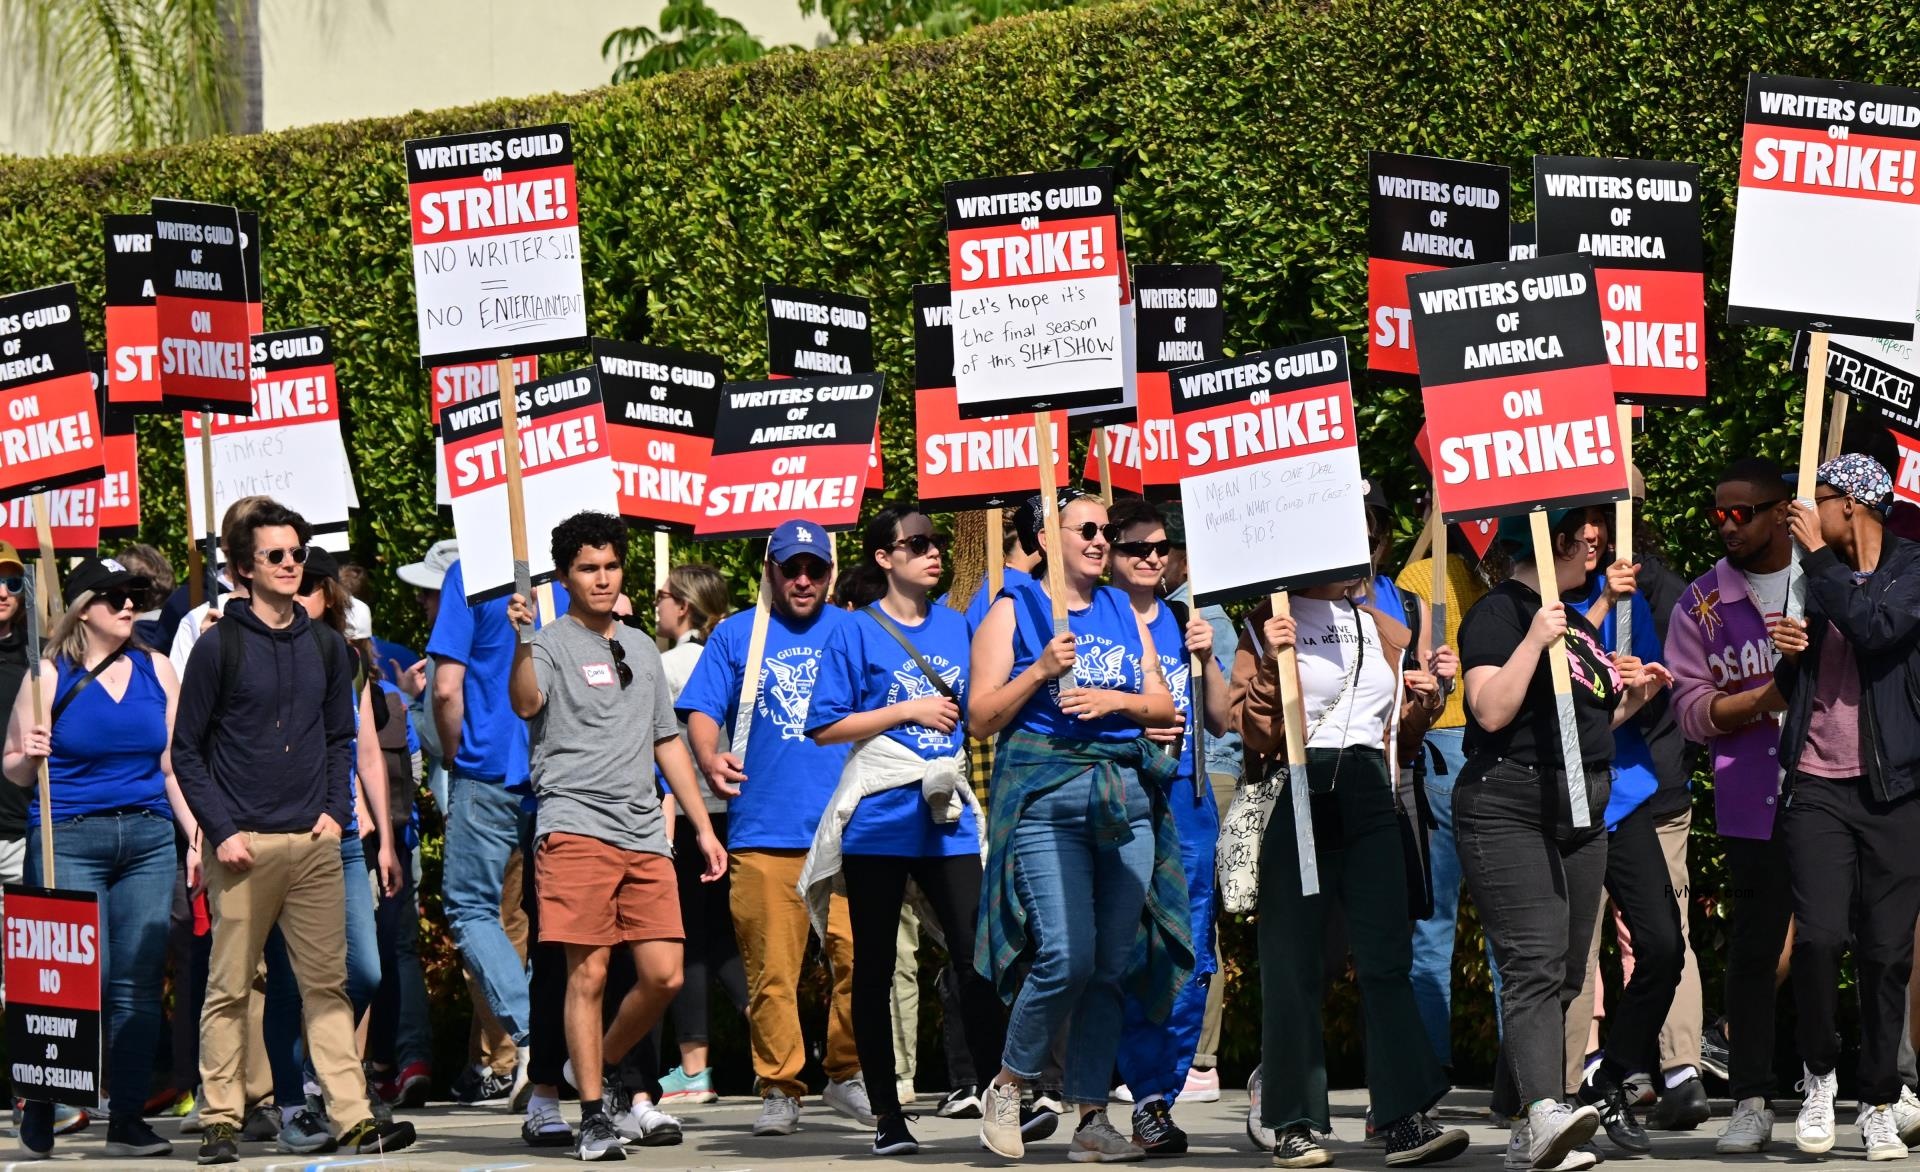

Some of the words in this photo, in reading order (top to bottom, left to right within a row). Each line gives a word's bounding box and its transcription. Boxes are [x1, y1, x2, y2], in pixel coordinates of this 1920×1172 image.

[1760, 92, 1856, 122] WRITERS
[1859, 101, 1920, 128] GUILD
[1828, 124, 1849, 140] ON
[416, 140, 504, 170] WRITERS
[507, 134, 564, 160] GUILD
[482, 167, 502, 182] ON
[1752, 137, 1916, 196] STRIKE!
[1378, 174, 1450, 204] WRITERS
[1453, 185, 1500, 210] GUILD
[1544, 173, 1632, 200] WRITERS
[1636, 179, 1693, 203] GUILD
[420, 178, 569, 235] STRIKE!
[956, 190, 1043, 219] WRITERS
[1045, 186, 1102, 210] GUILD
[1020, 216, 1040, 230] ON
[1430, 210, 1448, 228] OF
[1610, 207, 1631, 226] OF
[156, 220, 204, 243] WRITERS
[204, 224, 234, 246] GUILD
[1401, 231, 1475, 261] AMERICA
[190, 249, 203, 266] OF
[423, 246, 457, 275] NO
[467, 234, 575, 268] WRITERS!!
[960, 226, 1106, 282] STRIKE!
[1578, 233, 1666, 260] AMERICA
[174, 270, 223, 292] AMERICA
[1418, 280, 1520, 315] WRITERS
[1522, 272, 1587, 299] GUILD
[958, 298, 1000, 320] Let's
[1009, 288, 1050, 318] hope
[1062, 286, 1086, 306] it's
[1140, 288, 1187, 309] WRITERS
[1187, 288, 1218, 308] GUILD
[1608, 284, 1642, 312] ON
[22, 304, 71, 330] GUILD
[190, 310, 212, 334] ON
[426, 305, 463, 330] NO
[479, 294, 582, 329] ENTERTAINMENT
[771, 299, 830, 324] WRITERS
[830, 310, 867, 330] GUILD
[1174, 316, 1186, 334] OF
[1496, 312, 1520, 333] OF
[814, 330, 829, 346] OF
[961, 328, 995, 348] the
[1003, 320, 1036, 343] final
[1046, 316, 1097, 338] season
[3, 338, 21, 356] OF
[270, 335, 324, 361] GUILD
[1158, 341, 1204, 362] AMERICA
[1464, 335, 1564, 370] AMERICA
[1602, 320, 1699, 371] RIKE!
[0, 353, 55, 382] MERICA
[162, 336, 246, 382] STRIKE!
[794, 350, 852, 375] AMERICA
[962, 356, 981, 375] of
[988, 350, 1016, 369] this
[600, 356, 668, 382] WRITERS
[671, 366, 716, 390] GUILD
[1179, 360, 1272, 399] WRITERS
[1274, 350, 1338, 380] GUILD
[1805, 344, 1914, 409] TRIKE
[534, 377, 591, 406] GUILD
[650, 385, 668, 400] OF
[730, 387, 815, 409] WRITERS
[817, 384, 874, 402] GUILD
[1250, 389, 1270, 406] ON
[1502, 388, 1544, 420] ON
[9, 395, 40, 421] ON
[625, 402, 694, 428] AMERICA
[787, 408, 808, 421] OF
[0, 410, 94, 468] RIKE!
[750, 422, 836, 445] AMERICA
[1185, 395, 1345, 466] STRIKE!
[648, 440, 676, 463] ON
[1438, 415, 1616, 485] STRIKE!
[772, 456, 806, 476] ON
[610, 460, 708, 506] STRIKE
[1206, 476, 1240, 508] MEAN
[1250, 470, 1272, 492] IT'S
[1280, 468, 1303, 483] ONE
[705, 476, 858, 517] STRIKE!
[1246, 499, 1272, 518] WHAT
[1308, 492, 1319, 505] IT
[796, 526, 812, 543] LA
[1242, 520, 1276, 548] $10?
[1096, 636, 1112, 646] OF
[1303, 637, 1317, 646] LA
[1322, 634, 1372, 645] RESISTACE
[1326, 624, 1350, 634] VIVE
[777, 647, 812, 660] GUILD
[814, 650, 822, 658] O
[933, 656, 950, 668] OF
[1162, 656, 1178, 666] OF
[1126, 654, 1141, 693] AMERI
[756, 668, 770, 718] WRITERS
[7, 916, 96, 966] STRIKE!
[39, 968, 60, 994] ON
[26, 1014, 78, 1038] AMERICA
[46, 1044, 58, 1060] OF
[12, 1063, 44, 1086] GUILD
[44, 1066, 94, 1092] WRITERS
